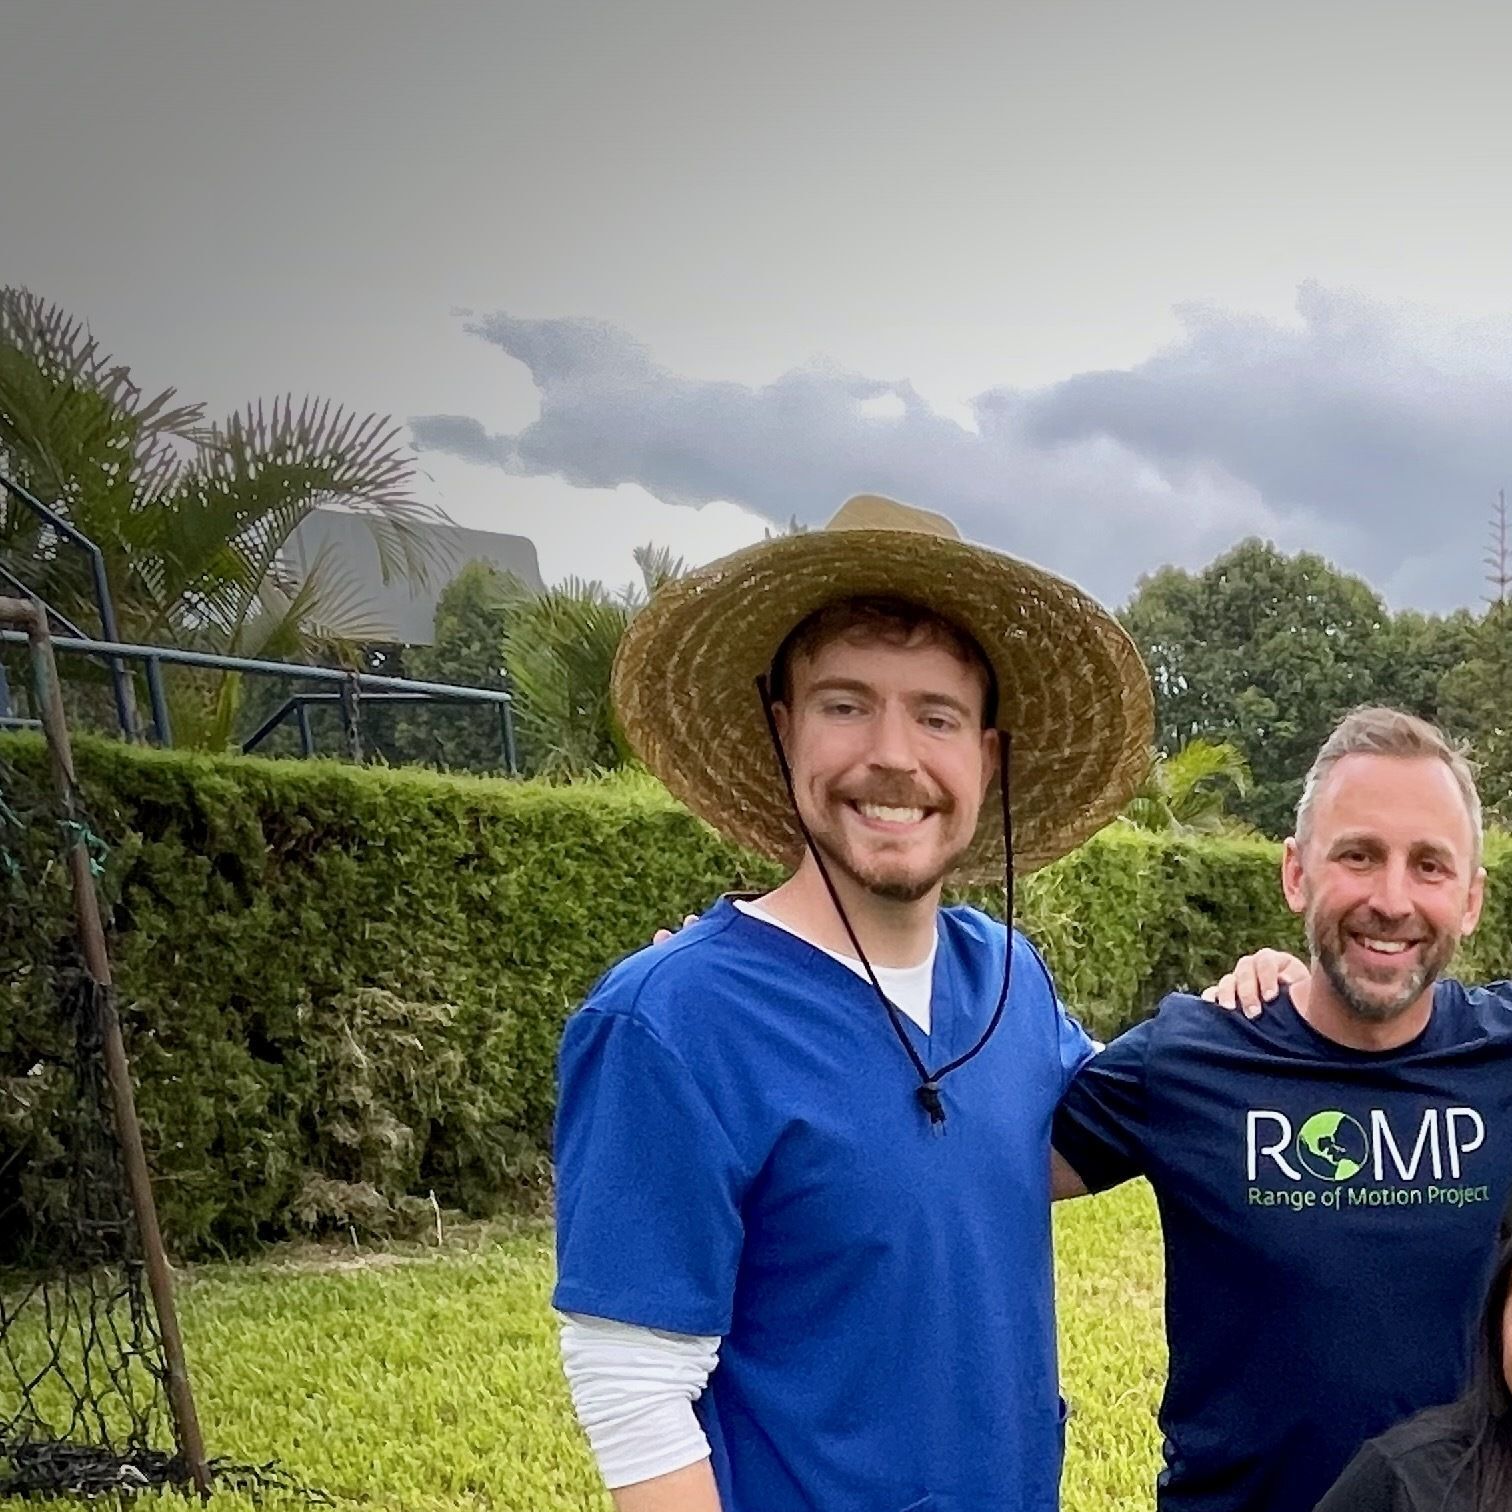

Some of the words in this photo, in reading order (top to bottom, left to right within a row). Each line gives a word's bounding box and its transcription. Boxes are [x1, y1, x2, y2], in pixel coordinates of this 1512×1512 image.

[1247, 1107, 1485, 1182] ROMP
[1248, 1187, 1317, 1211] Range
[1320, 1186, 1342, 1210] of
[1348, 1186, 1422, 1206] Motion
[1427, 1184, 1490, 1208] Project
